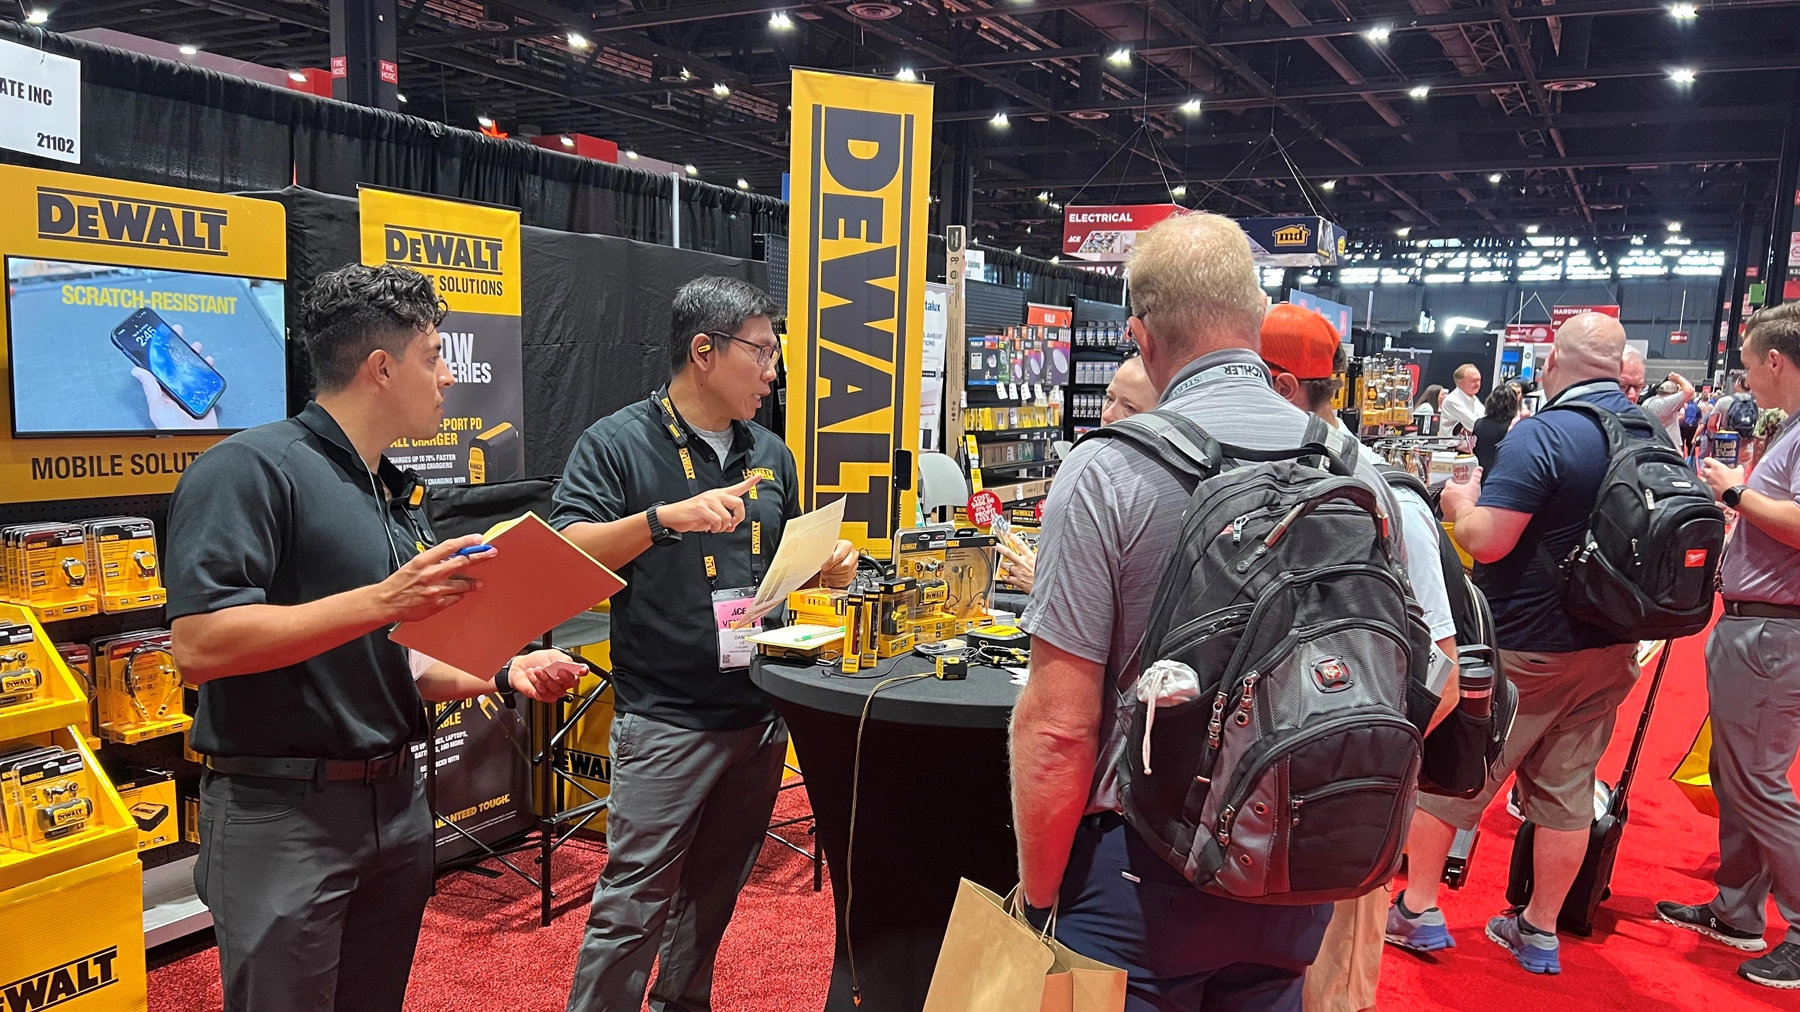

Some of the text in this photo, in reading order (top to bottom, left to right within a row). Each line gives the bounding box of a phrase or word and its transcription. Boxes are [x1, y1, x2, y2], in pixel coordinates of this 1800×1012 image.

[381, 63, 394, 72] FIRE
[381, 71, 396, 81] HOSE
[28, 84, 52, 106] INC
[37, 132, 75, 154] 21102
[1068, 213, 1133, 222] ELECTRICAL
[1067, 235, 1081, 243] ACE
[1279, 230, 1303, 240] md
[439, 275, 503, 296] SOLUTIONS
[61, 284, 238, 315] SCRATCH-RESISTANT
[136, 326, 157, 347] 2:45
[447, 361, 492, 384] ERIES
[470, 417, 483, 430] PD
[425, 454, 436, 462] 70%
[31, 455, 123, 480] MOBILE
[403, 464, 426, 472] STANDARD
[427, 462, 453, 470] CHARGERS
[428, 478, 453, 486] CHARGING
[731, 607, 747, 616] ACE
[450, 738, 464, 748] MORE
[448, 754, 460, 763] WITH
